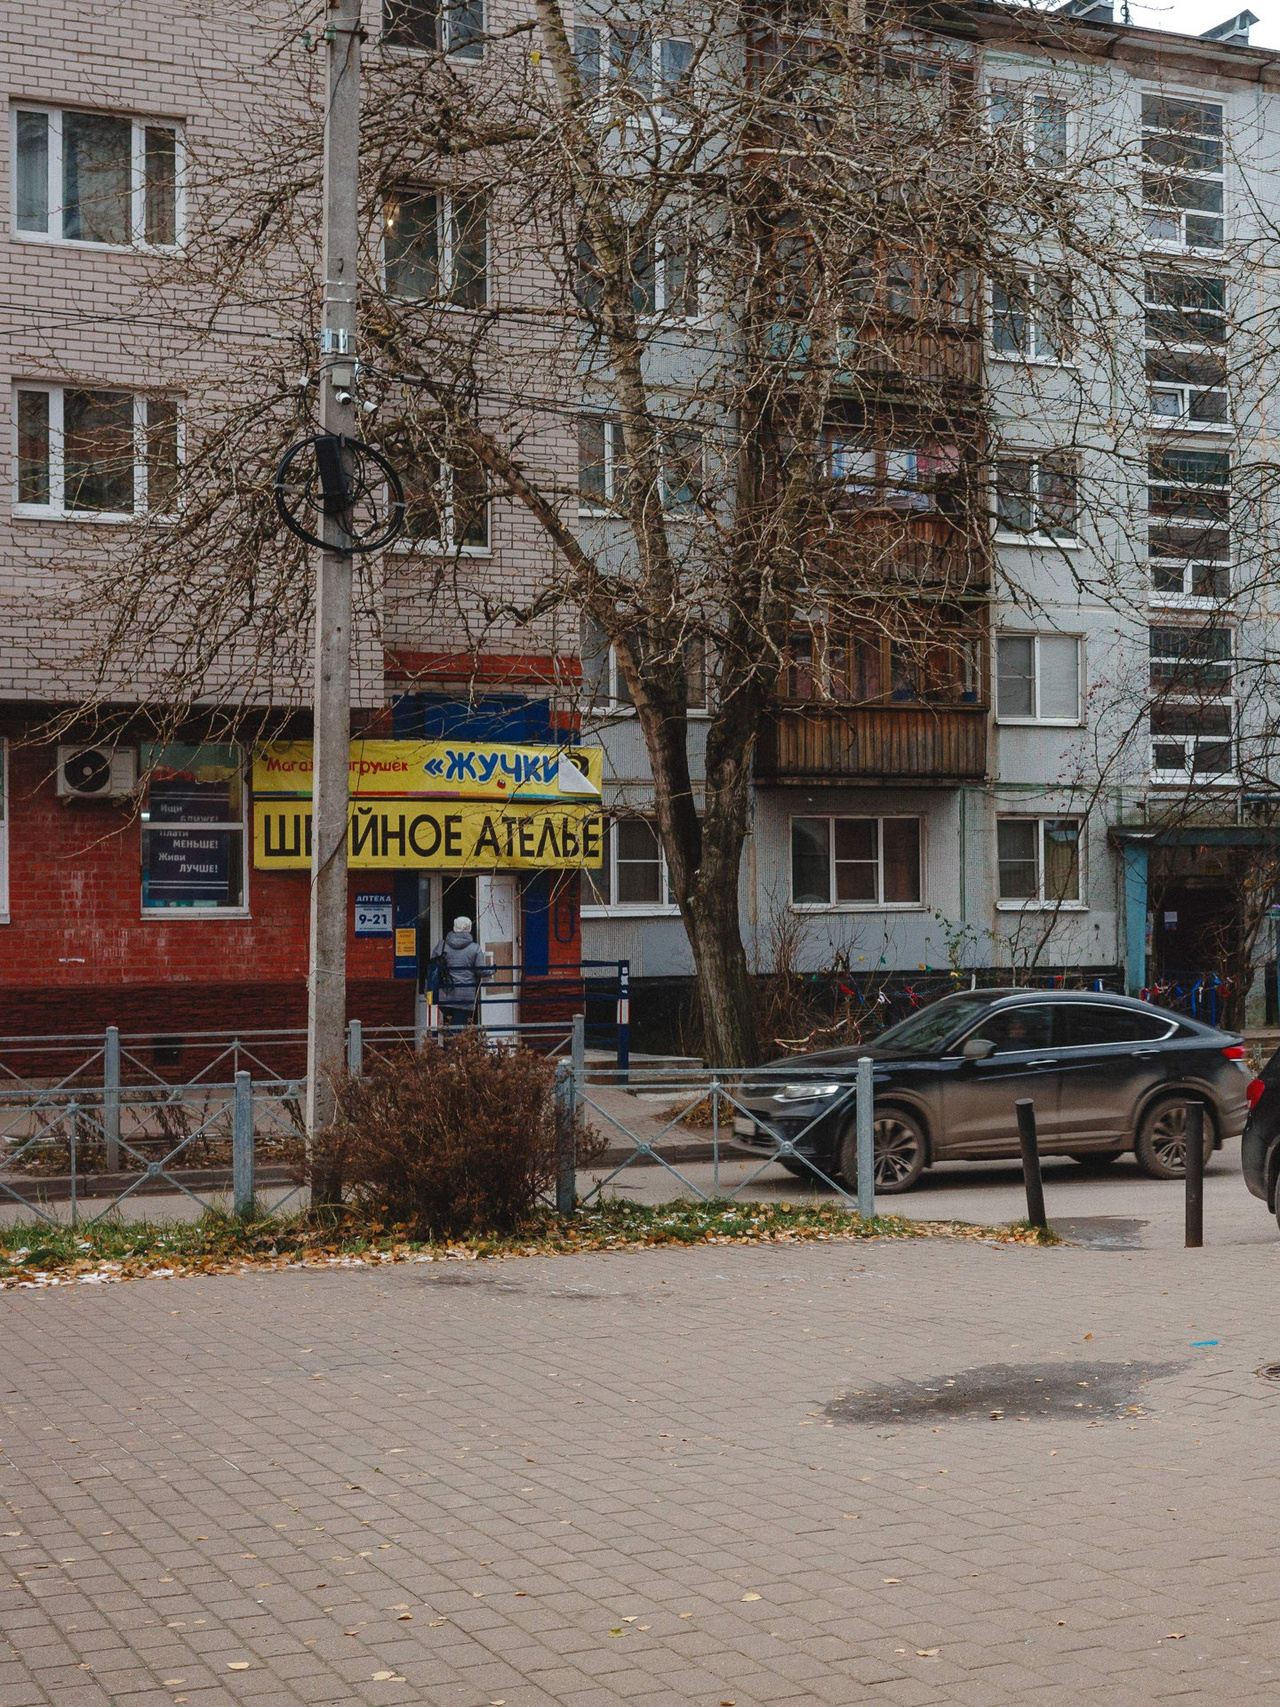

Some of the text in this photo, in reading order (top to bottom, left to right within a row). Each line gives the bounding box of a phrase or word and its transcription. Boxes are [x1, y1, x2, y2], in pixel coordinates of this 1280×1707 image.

[160, 803, 183, 813] Ищи
[264, 806, 600, 858] ШЙНОЕ АТЕЛЬЕ
[172, 840, 219, 849] МЕНЬШЕ!
[158, 852, 186, 862] Живи
[178, 863, 218, 873] ЛУЧШЕ!
[356, 894, 392, 902] АПТЕКА
[358, 913, 387, 925] 9-21
